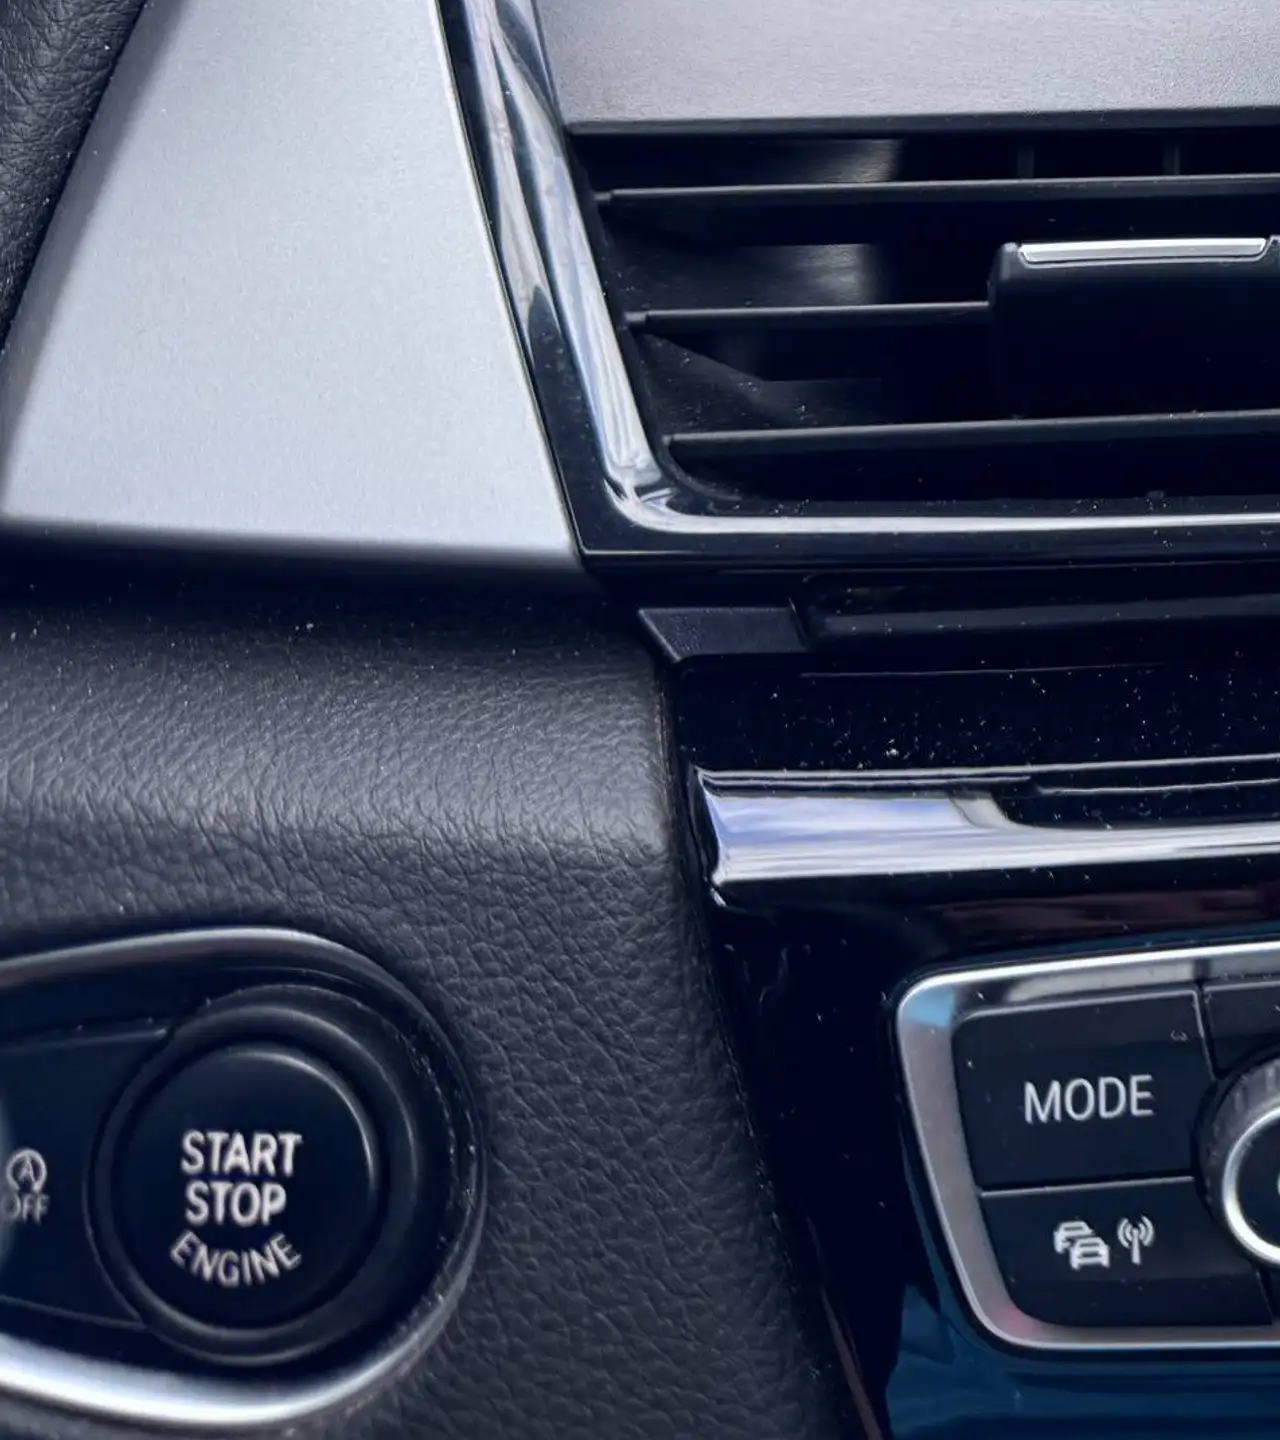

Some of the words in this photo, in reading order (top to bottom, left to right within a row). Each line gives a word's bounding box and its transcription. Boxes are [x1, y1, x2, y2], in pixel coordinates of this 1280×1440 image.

[1024, 1074, 1154, 1124] MODE
[181, 1130, 302, 1175] START
[186, 1180, 287, 1226] STOP
[170, 1230, 301, 1287] ENGINE
